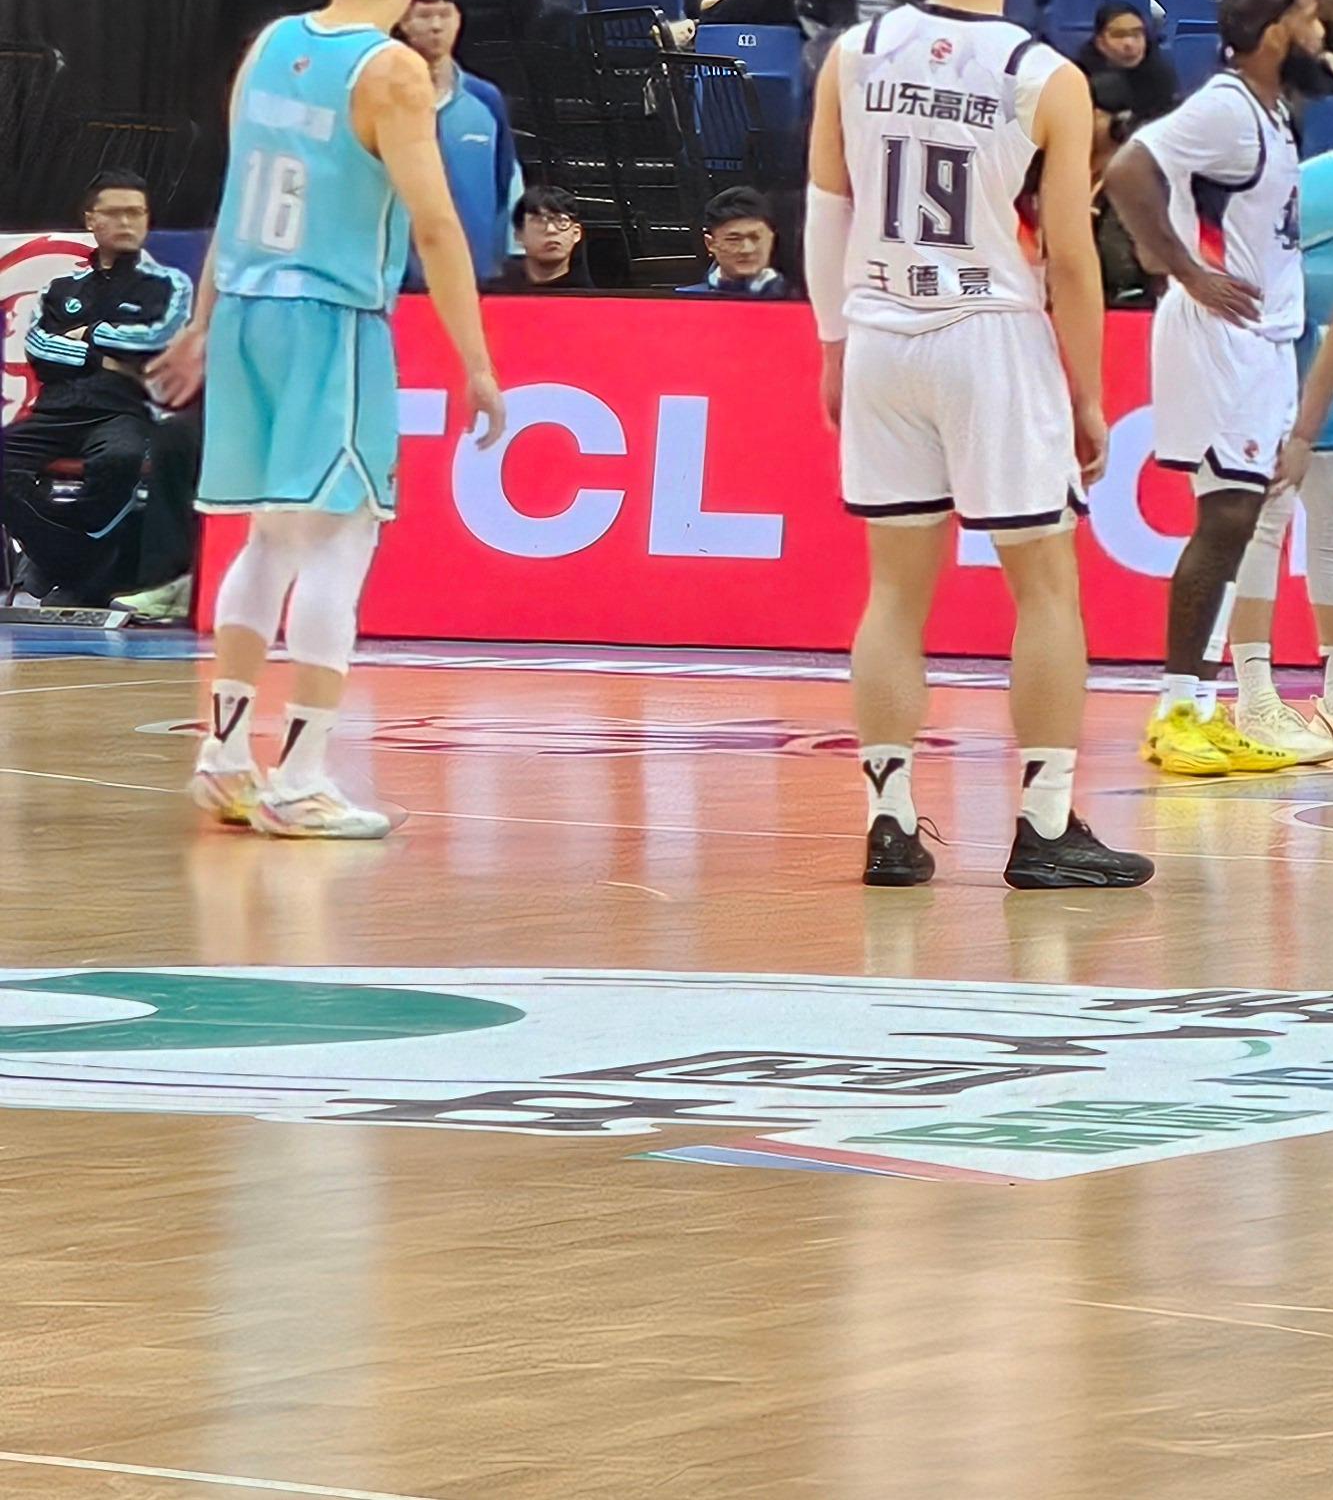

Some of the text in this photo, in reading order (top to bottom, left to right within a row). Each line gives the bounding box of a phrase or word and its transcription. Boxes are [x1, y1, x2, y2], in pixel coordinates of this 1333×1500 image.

[865, 79, 999, 130] 山东高速
[881, 135, 977, 250] 19
